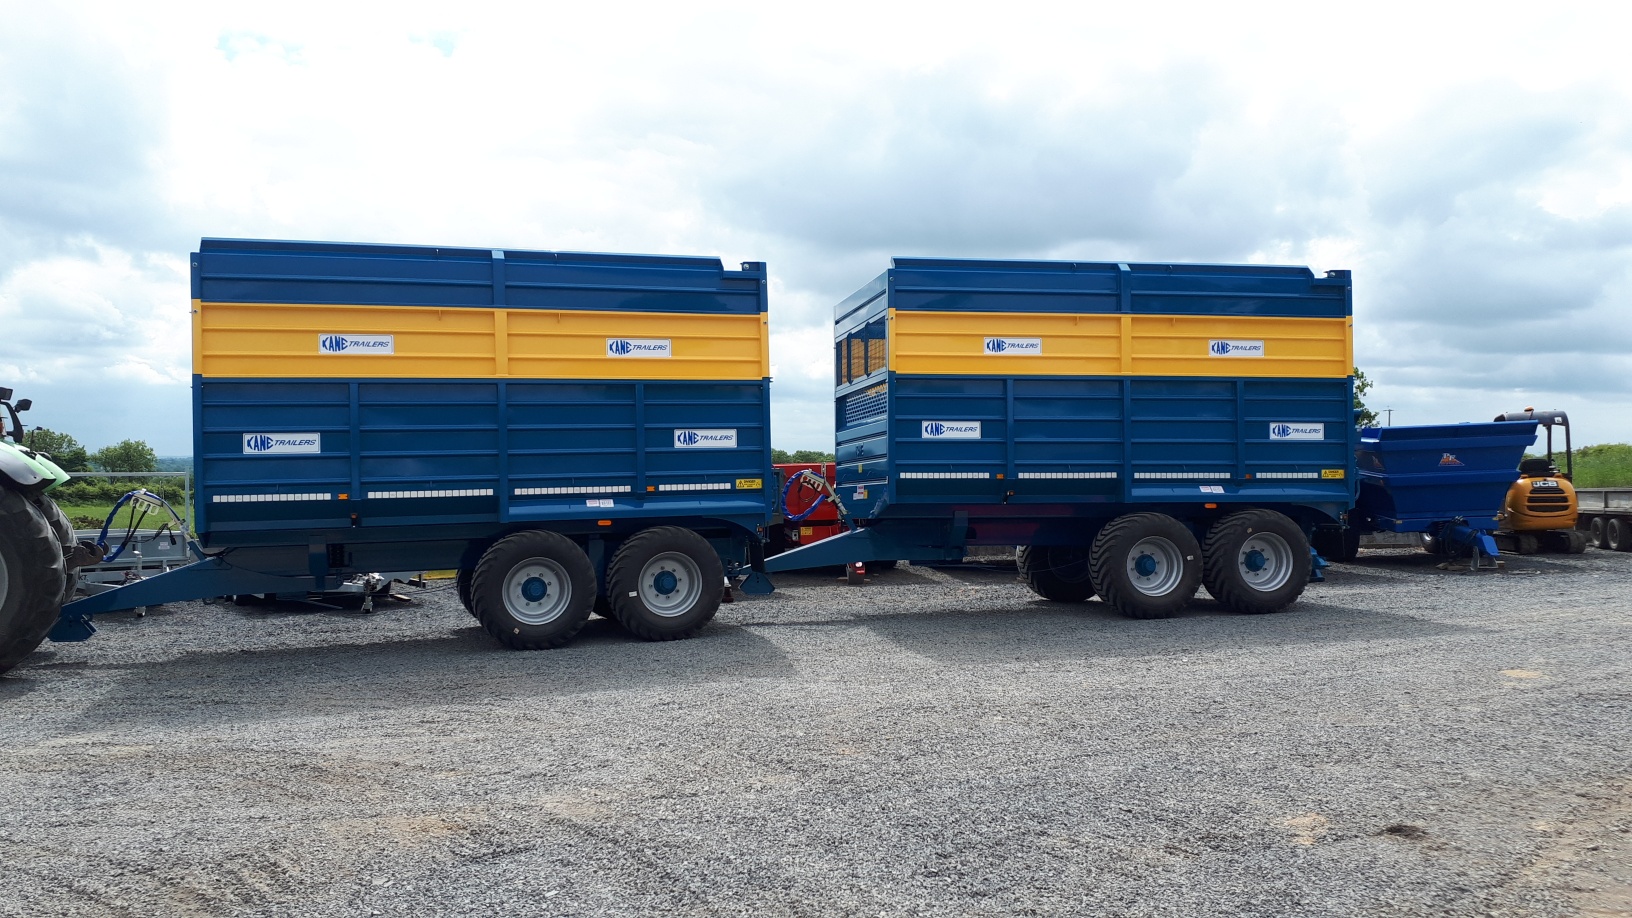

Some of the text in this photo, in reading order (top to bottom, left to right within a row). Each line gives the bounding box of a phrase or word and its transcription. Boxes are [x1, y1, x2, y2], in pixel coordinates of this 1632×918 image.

[322, 336, 348, 352] KANE
[609, 340, 632, 355] KANE
[986, 338, 1006, 352] KANE
[1212, 341, 1230, 354] KANE
[925, 422, 945, 436] KANE
[1272, 424, 1291, 438] KANE
[247, 434, 274, 452] KANE
[678, 430, 699, 446] KANE
